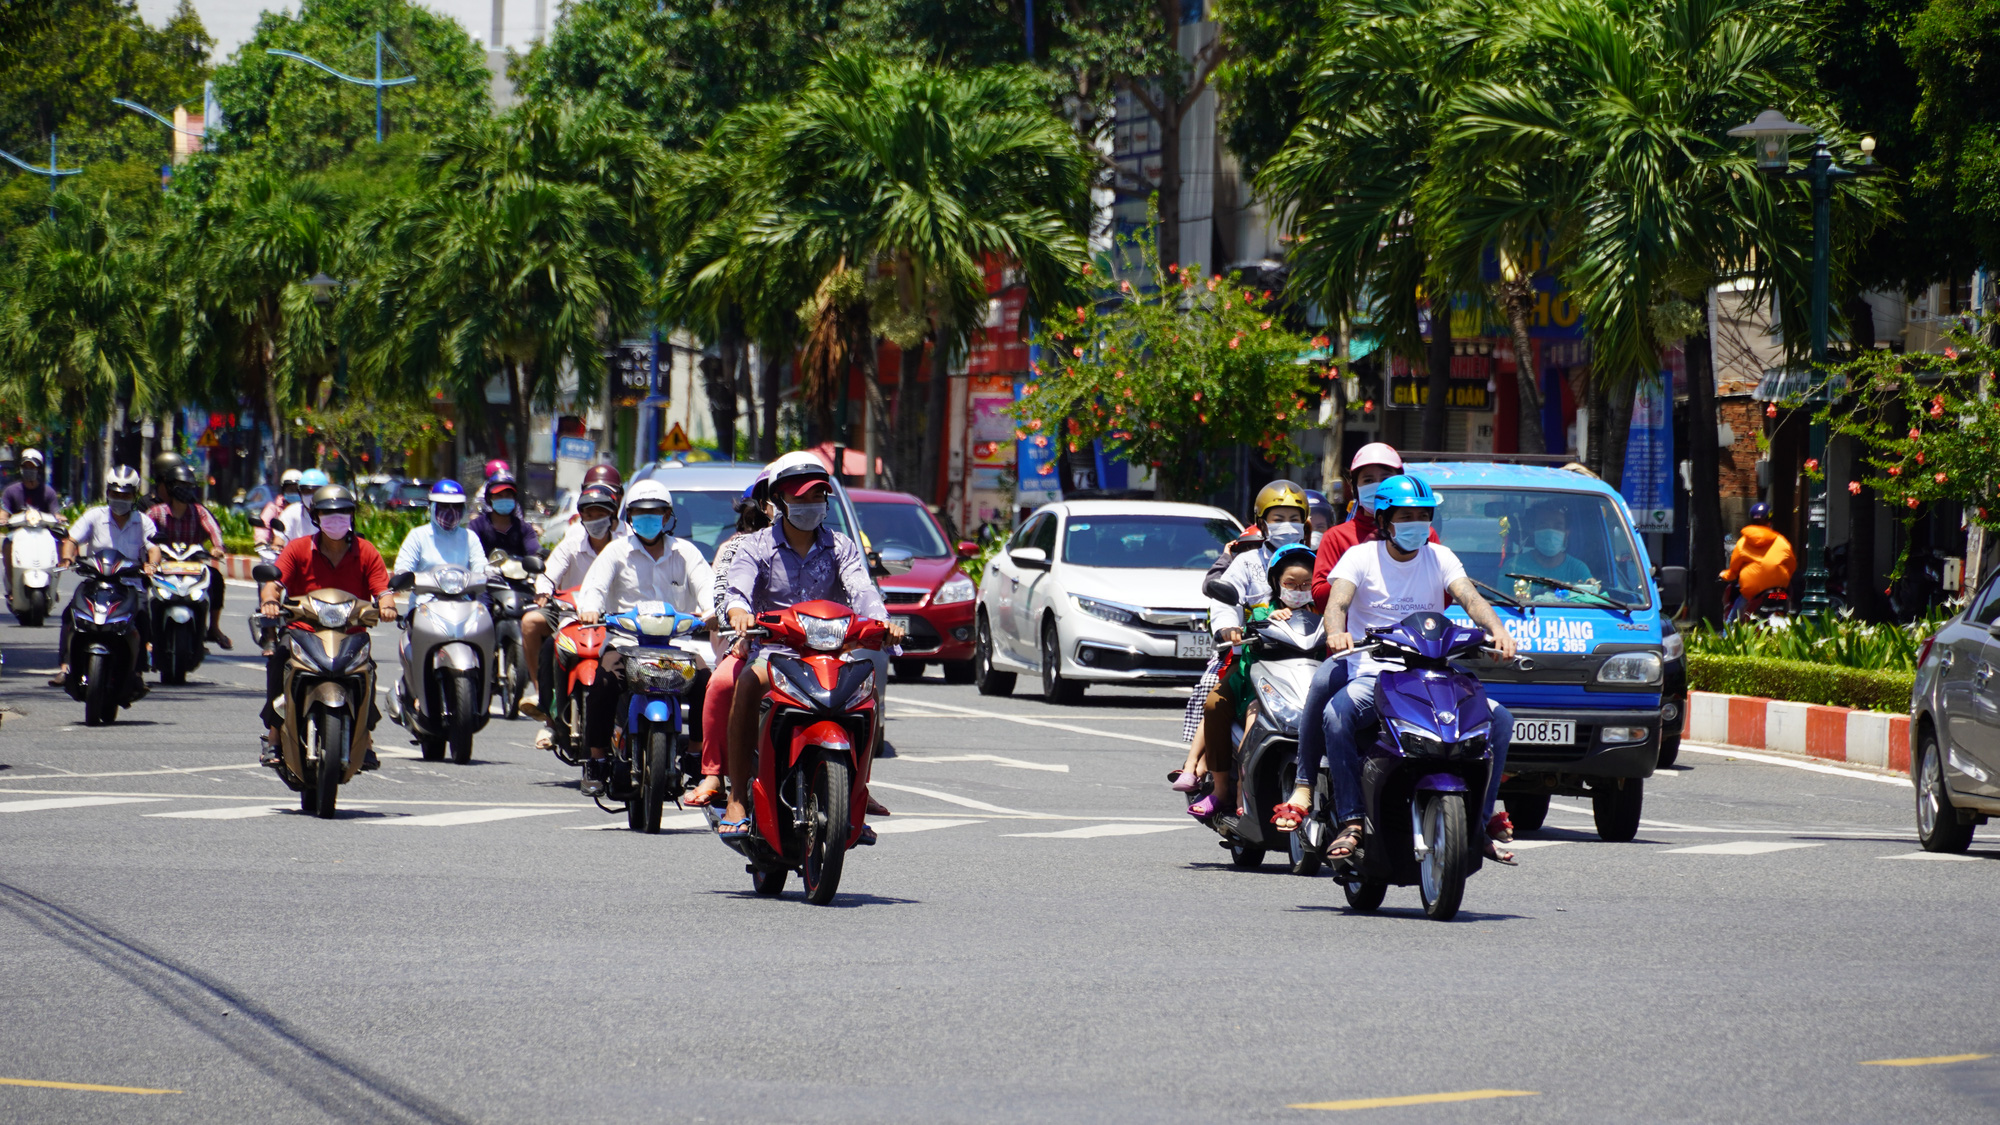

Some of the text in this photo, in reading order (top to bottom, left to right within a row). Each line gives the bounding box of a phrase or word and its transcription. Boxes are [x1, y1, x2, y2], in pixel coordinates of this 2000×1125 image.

[1636, 522, 1670, 531] ombank
[1545, 617, 1594, 640] HÀNG
[1182, 646, 1212, 657] 253.5
[1514, 637, 1587, 653] 33 125 365
[1511, 722, 1570, 743] -008.51
